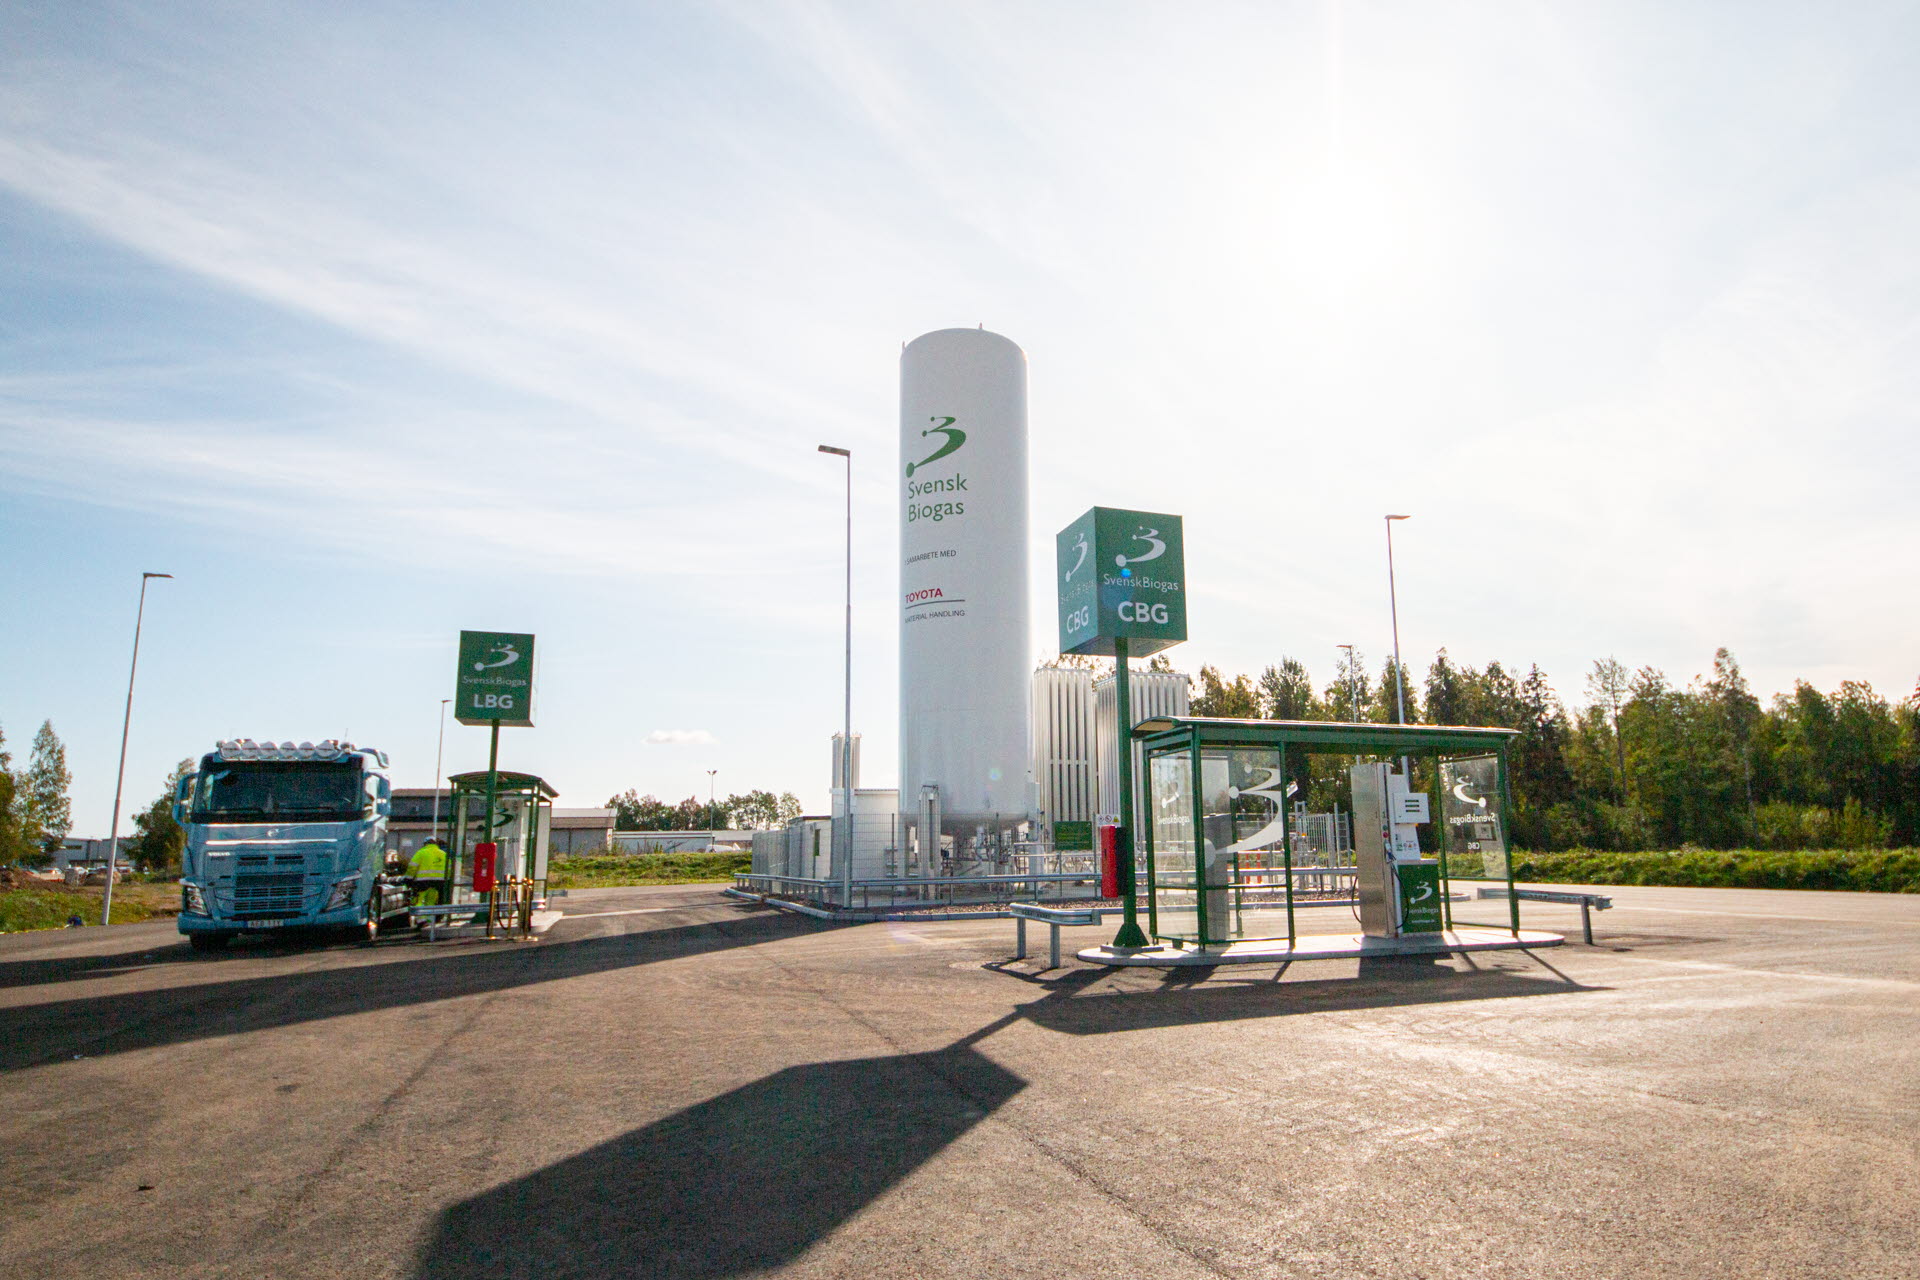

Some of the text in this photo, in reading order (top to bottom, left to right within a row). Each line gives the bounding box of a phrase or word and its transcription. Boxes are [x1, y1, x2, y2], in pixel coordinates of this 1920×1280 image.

[908, 473, 968, 499] Svensk
[908, 501, 964, 522] Biogas
[907, 551, 938, 566] SAMARBETE
[940, 549, 957, 558] MED
[1103, 573, 1179, 593] SvenskBiogas
[905, 587, 943, 604] TOYOTA
[929, 609, 966, 619] HANDLING
[1066, 605, 1089, 634] CBG
[1117, 600, 1169, 624] CBG
[473, 693, 514, 709] LBG
